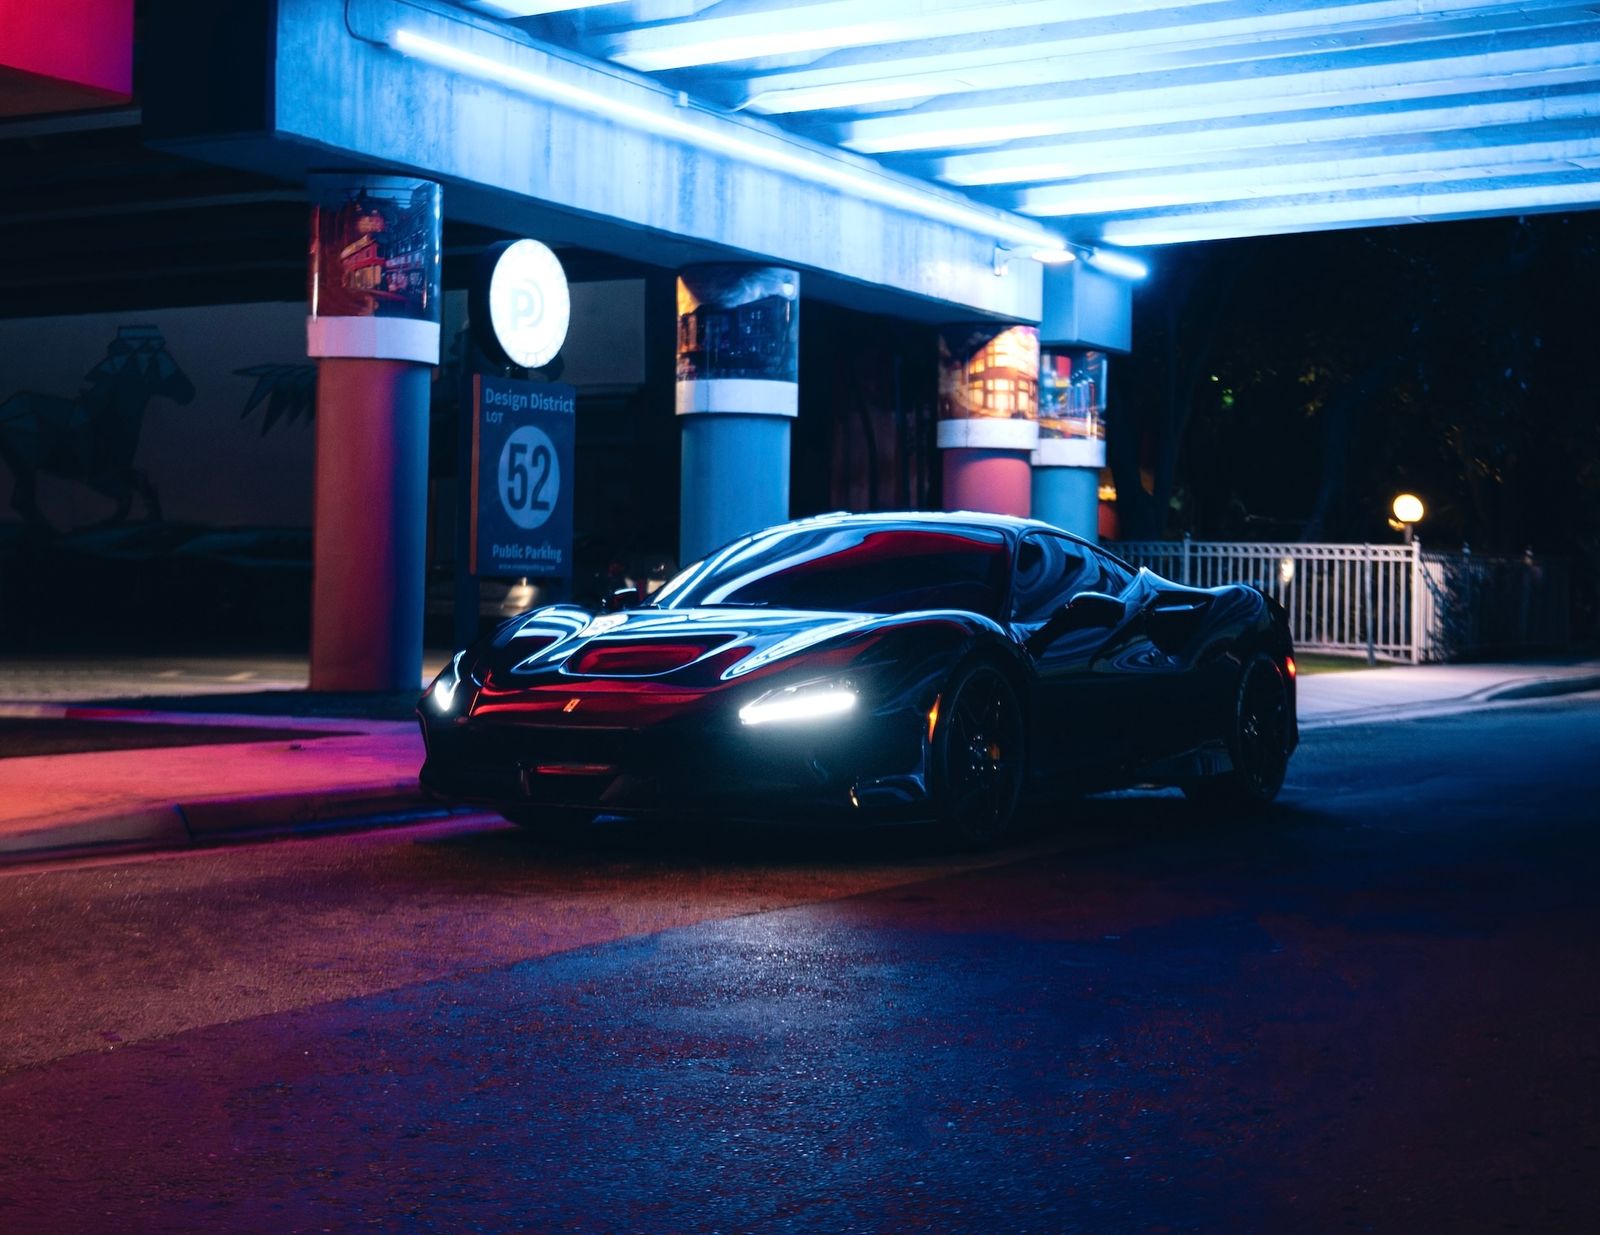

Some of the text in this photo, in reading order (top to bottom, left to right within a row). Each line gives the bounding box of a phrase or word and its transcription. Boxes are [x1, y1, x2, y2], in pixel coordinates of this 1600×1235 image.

[485, 388, 575, 413] Design District
[485, 411, 504, 424] LOT
[507, 443, 551, 511] 52
[492, 543, 562, 564] Public Parking
